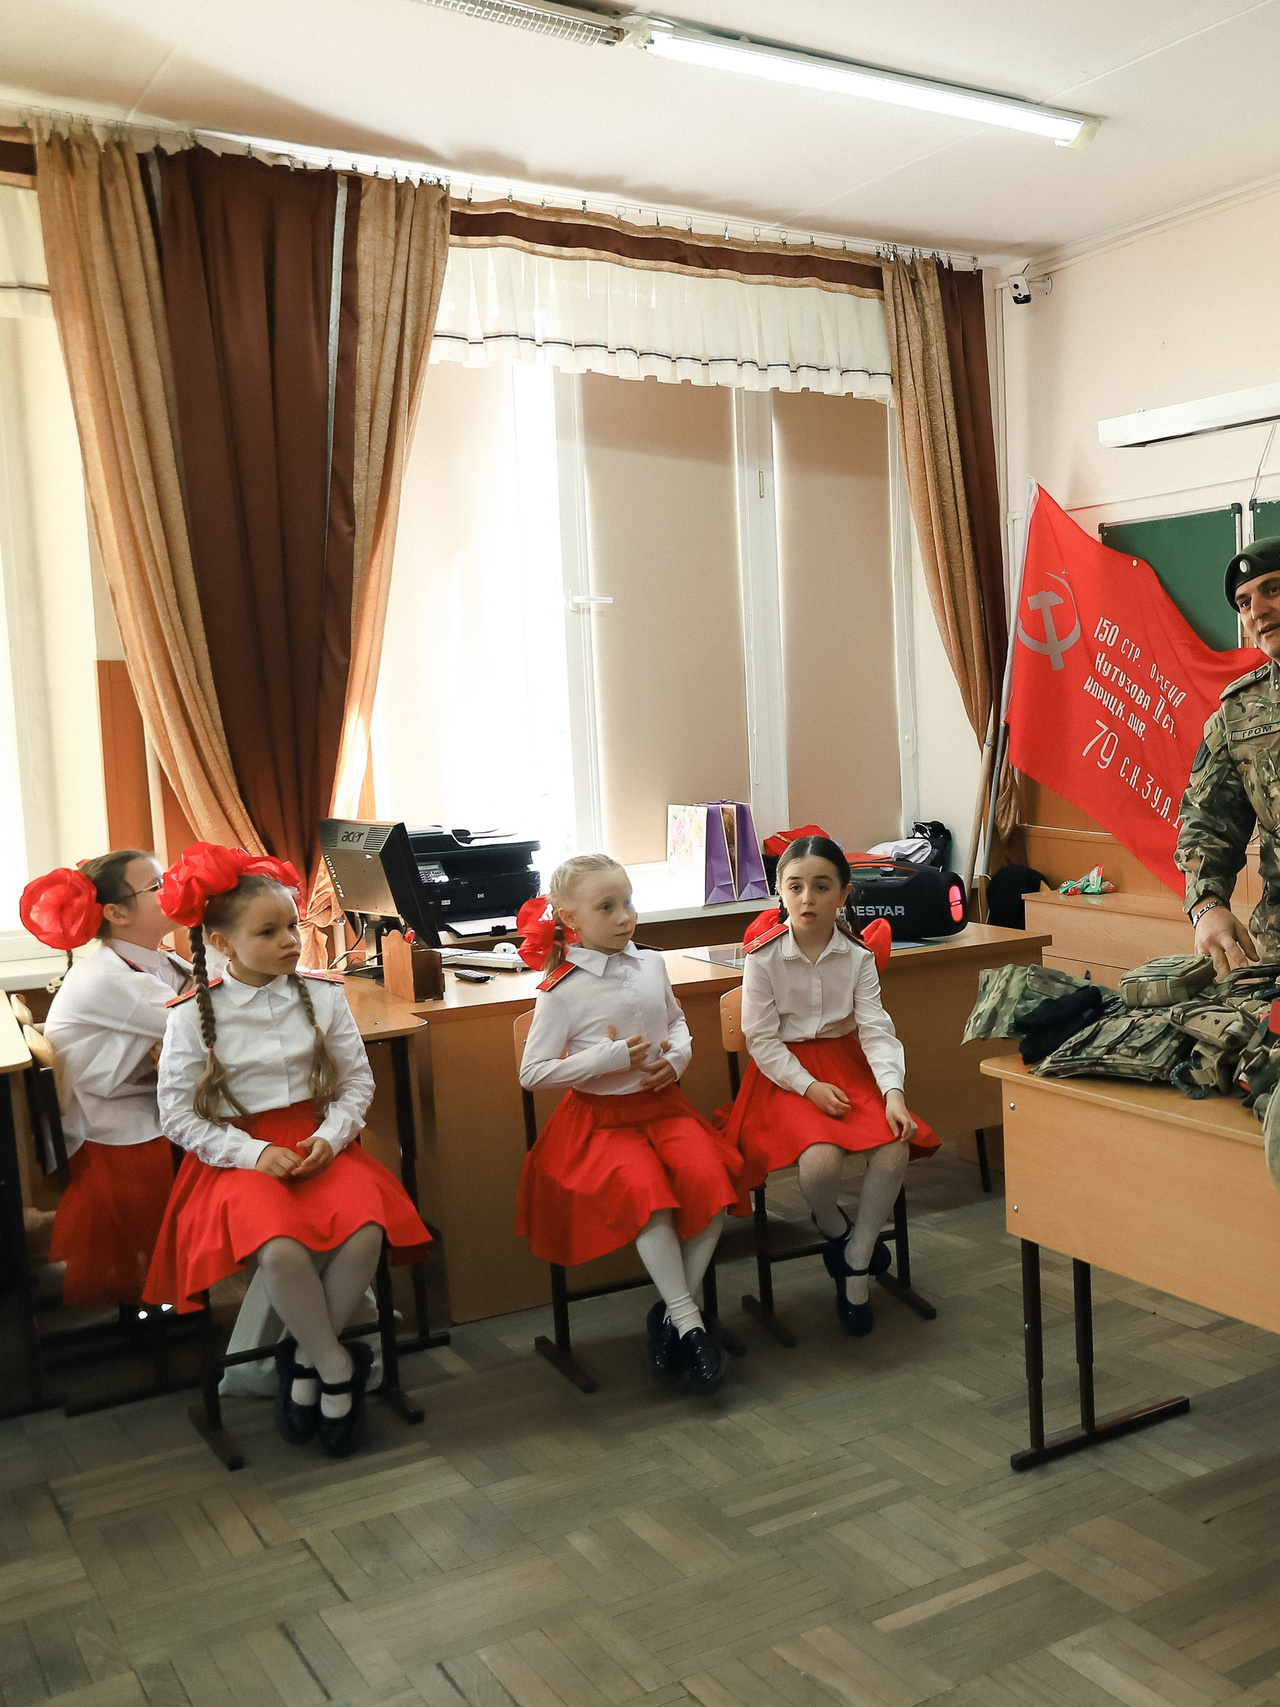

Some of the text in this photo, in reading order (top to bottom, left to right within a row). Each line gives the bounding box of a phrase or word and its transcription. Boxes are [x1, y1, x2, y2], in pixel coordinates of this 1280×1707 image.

[1093, 616, 1120, 648] 150
[1241, 725, 1273, 739] ГРОМ
[1081, 719, 1119, 770] 79
[341, 830, 365, 844] acer
